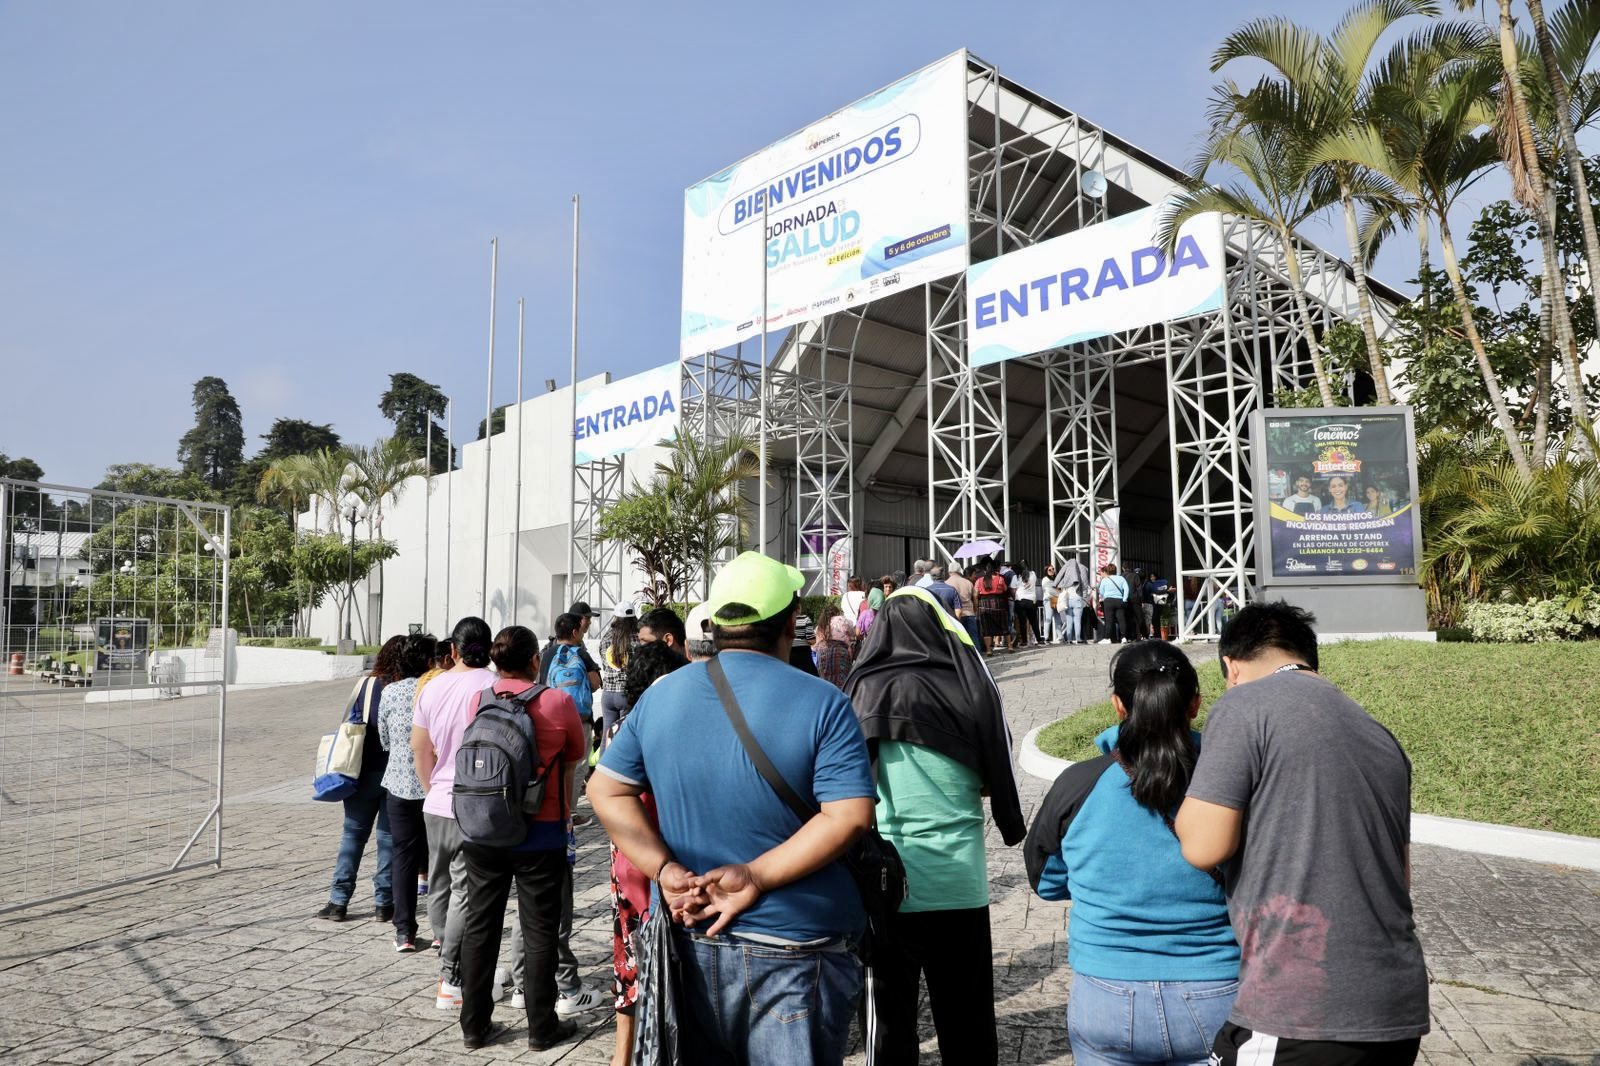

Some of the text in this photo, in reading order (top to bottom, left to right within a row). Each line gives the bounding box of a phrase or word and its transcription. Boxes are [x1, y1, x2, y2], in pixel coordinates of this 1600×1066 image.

[734, 126, 902, 225] BIENVENIDOS
[766, 201, 837, 240] JORNADA
[767, 209, 861, 268] SALUD
[888, 247, 894, 255] 5
[894, 247, 900, 255] y
[906, 241, 916, 249] de
[916, 229, 948, 245] octubre
[975, 234, 1209, 330] ENTRADA
[575, 389, 676, 441] ENTRADA
[1313, 427, 1360, 440] Tenemos
[1286, 518, 1395, 531] INOLVIDABLES REGRESAN
[1305, 511, 1373, 521] LOS MOMENTOS
[1299, 533, 1339, 541] ARRENDA
